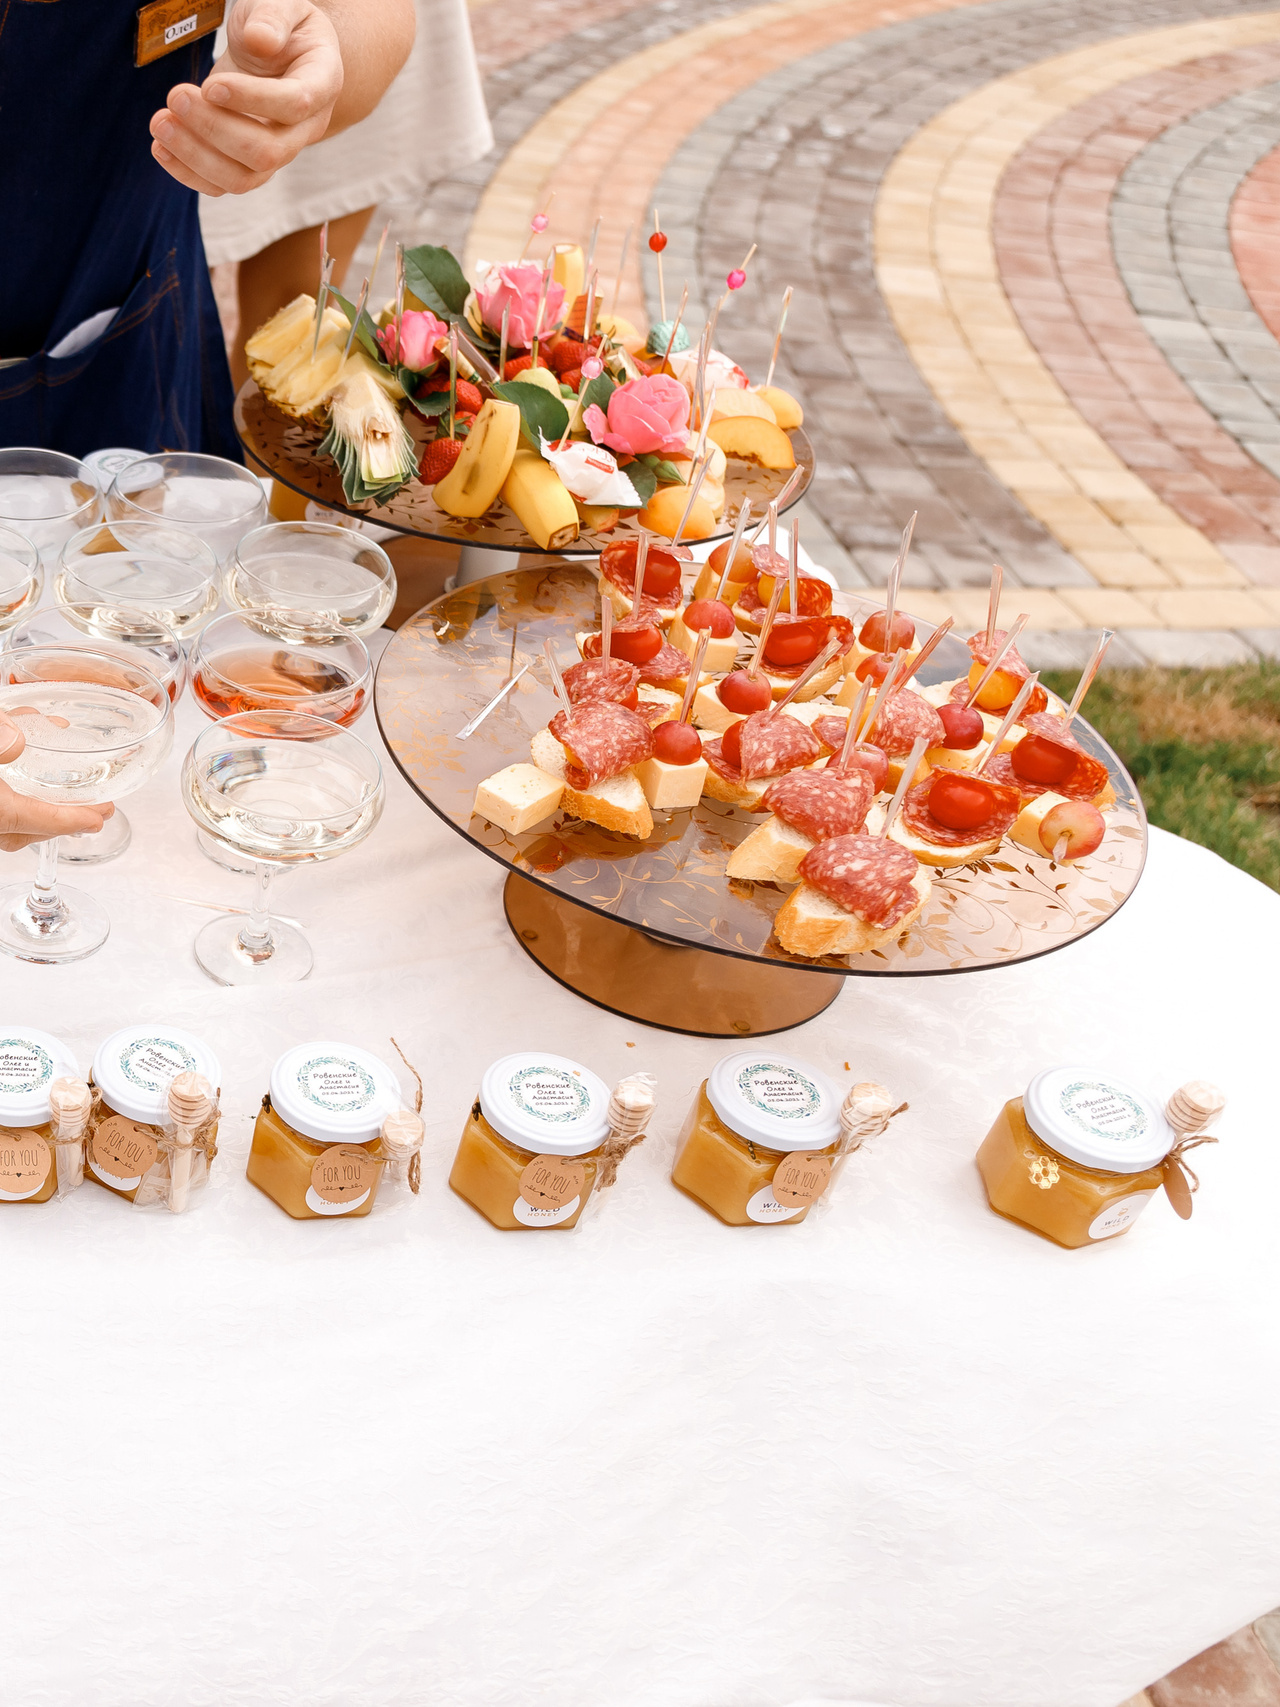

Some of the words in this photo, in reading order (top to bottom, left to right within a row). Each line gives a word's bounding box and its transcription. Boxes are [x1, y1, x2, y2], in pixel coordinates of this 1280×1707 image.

[166, 21, 196, 39] Олег
[149, 1057, 166, 1067] Олег
[1076, 1095, 1116, 1109] Ровенские
[1091, 1105, 1109, 1113] Олег
[1091, 1107, 1126, 1120] Анастасия
[105, 1130, 121, 1150] FOR
[122, 1140, 144, 1163] YOU
[0, 1150, 16, 1166] FOR
[19, 1149, 39, 1166] YOU
[323, 1167, 339, 1182] FOR
[342, 1165, 360, 1180] YOU
[532, 1167, 551, 1186] FOR
[550, 1174, 570, 1195] YOU
[783, 1167, 800, 1185] FOR
[801, 1171, 819, 1189] YOU
[1104, 1216, 1130, 1226] WILD
